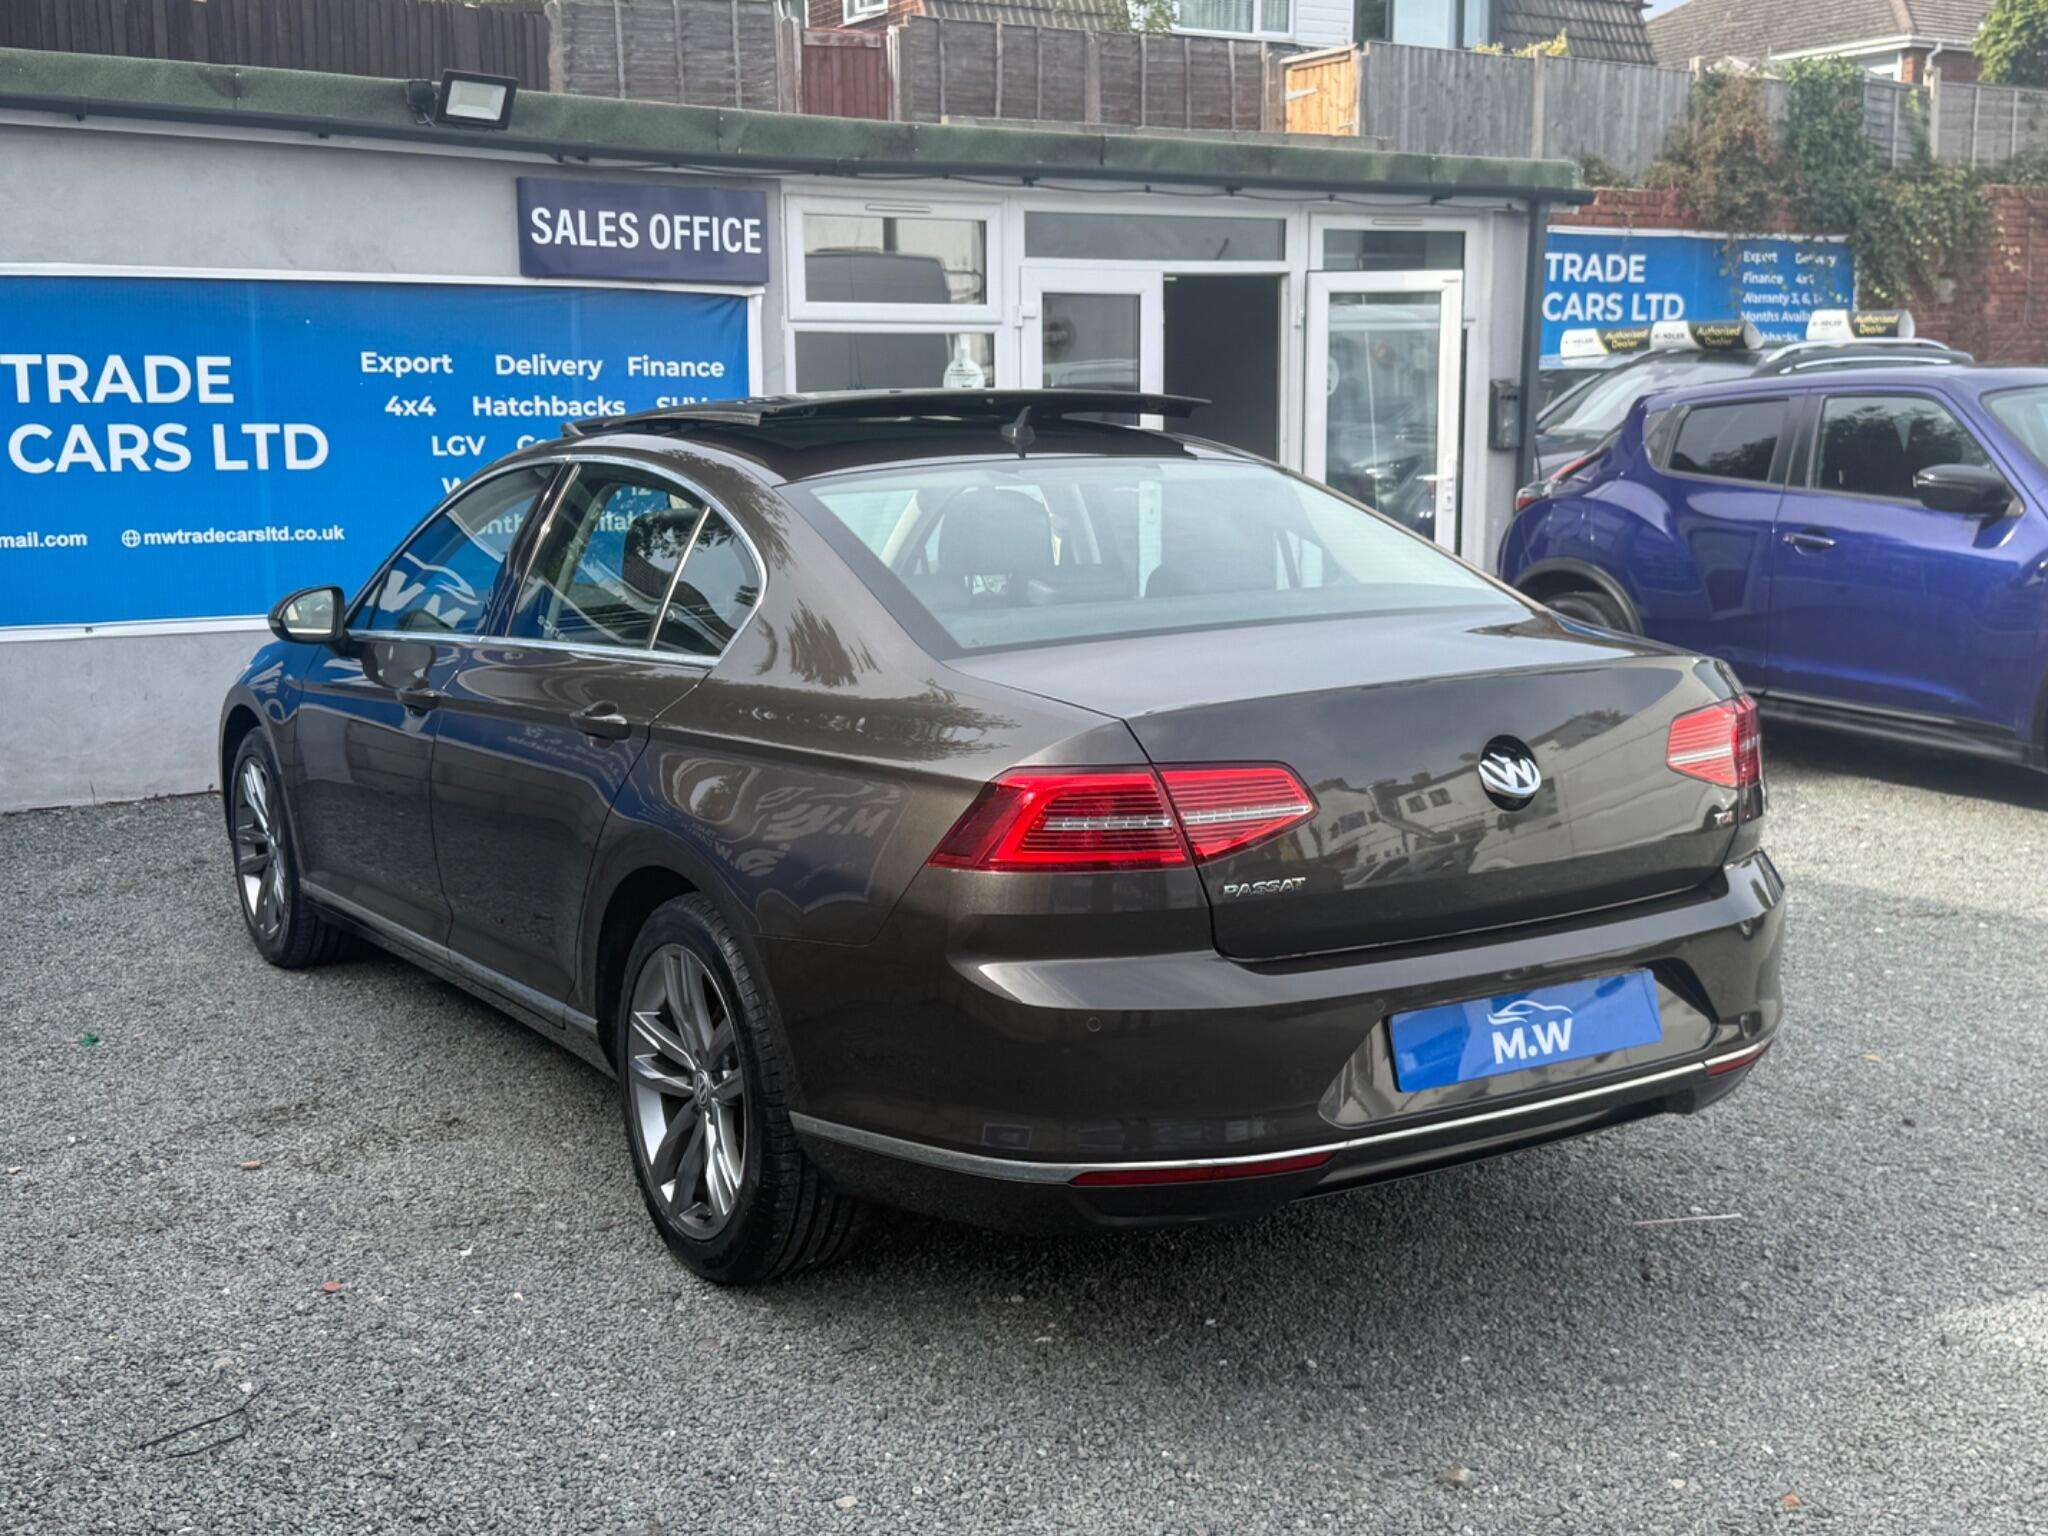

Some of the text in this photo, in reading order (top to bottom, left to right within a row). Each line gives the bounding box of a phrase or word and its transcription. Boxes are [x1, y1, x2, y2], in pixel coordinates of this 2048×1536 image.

[531, 207, 762, 254] SALES OFFICE
[1544, 252, 1647, 284] TRADE
[1743, 251, 1778, 265] Export
[1743, 271, 1784, 284] Finance
[1542, 292, 1685, 322] CARS LTD
[1743, 291, 1789, 306] Warranty
[0, 354, 234, 404] TRADE
[360, 351, 725, 381] Export Delivery Finance
[384, 396, 436, 417] 4x4
[472, 395, 625, 417] Hatchbacks
[8, 422, 329, 474] CARS LTD
[431, 434, 486, 457] LGV
[0, 524, 345, 549] mail.com mwtradecarsltd.co.uk
[1223, 876, 1306, 897] PASSAT
[1492, 1017, 1573, 1065] M.W
